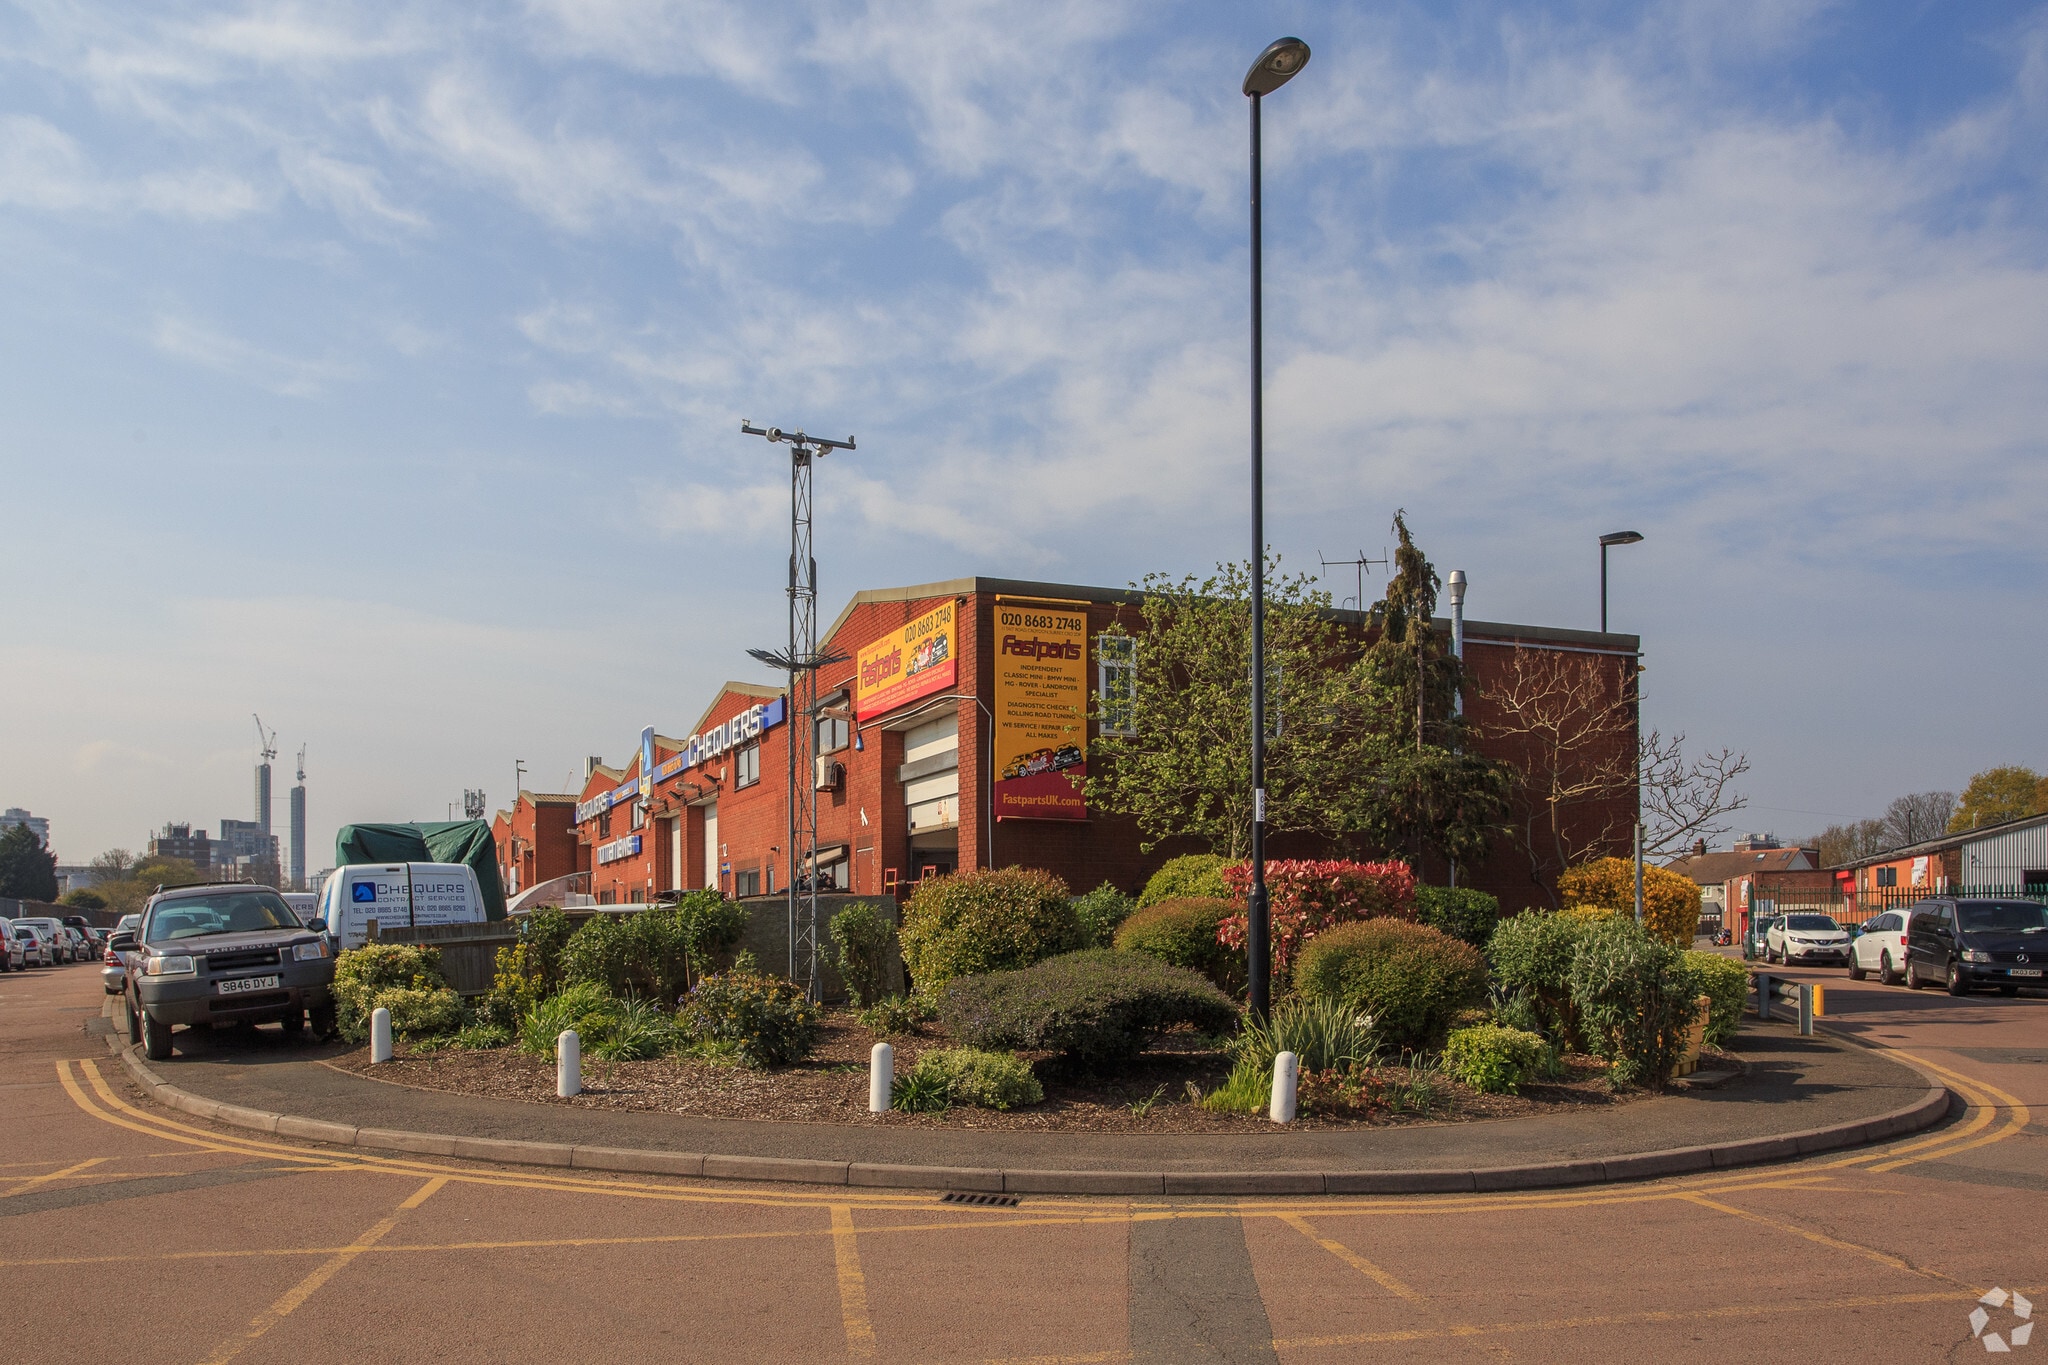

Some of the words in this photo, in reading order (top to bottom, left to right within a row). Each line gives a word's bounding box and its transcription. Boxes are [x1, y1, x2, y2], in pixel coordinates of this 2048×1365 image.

[904, 624, 916, 644] 020
[917, 614, 934, 638] 8683
[935, 605, 951, 629] 2748
[1001, 612, 1022, 626] 020
[1024, 614, 1052, 629] 8683
[1056, 618, 1081, 631] 2748
[1002, 635, 1081, 662] Fastparts
[860, 644, 902, 690] Fastparts
[688, 704, 764, 767] CHEQUERS
[1003, 793, 1080, 807] FastpartsUK.com
[377, 884, 465, 894] CHEQUERS
[223, 980, 250, 992] S846
[253, 978, 274, 988] DYJ
